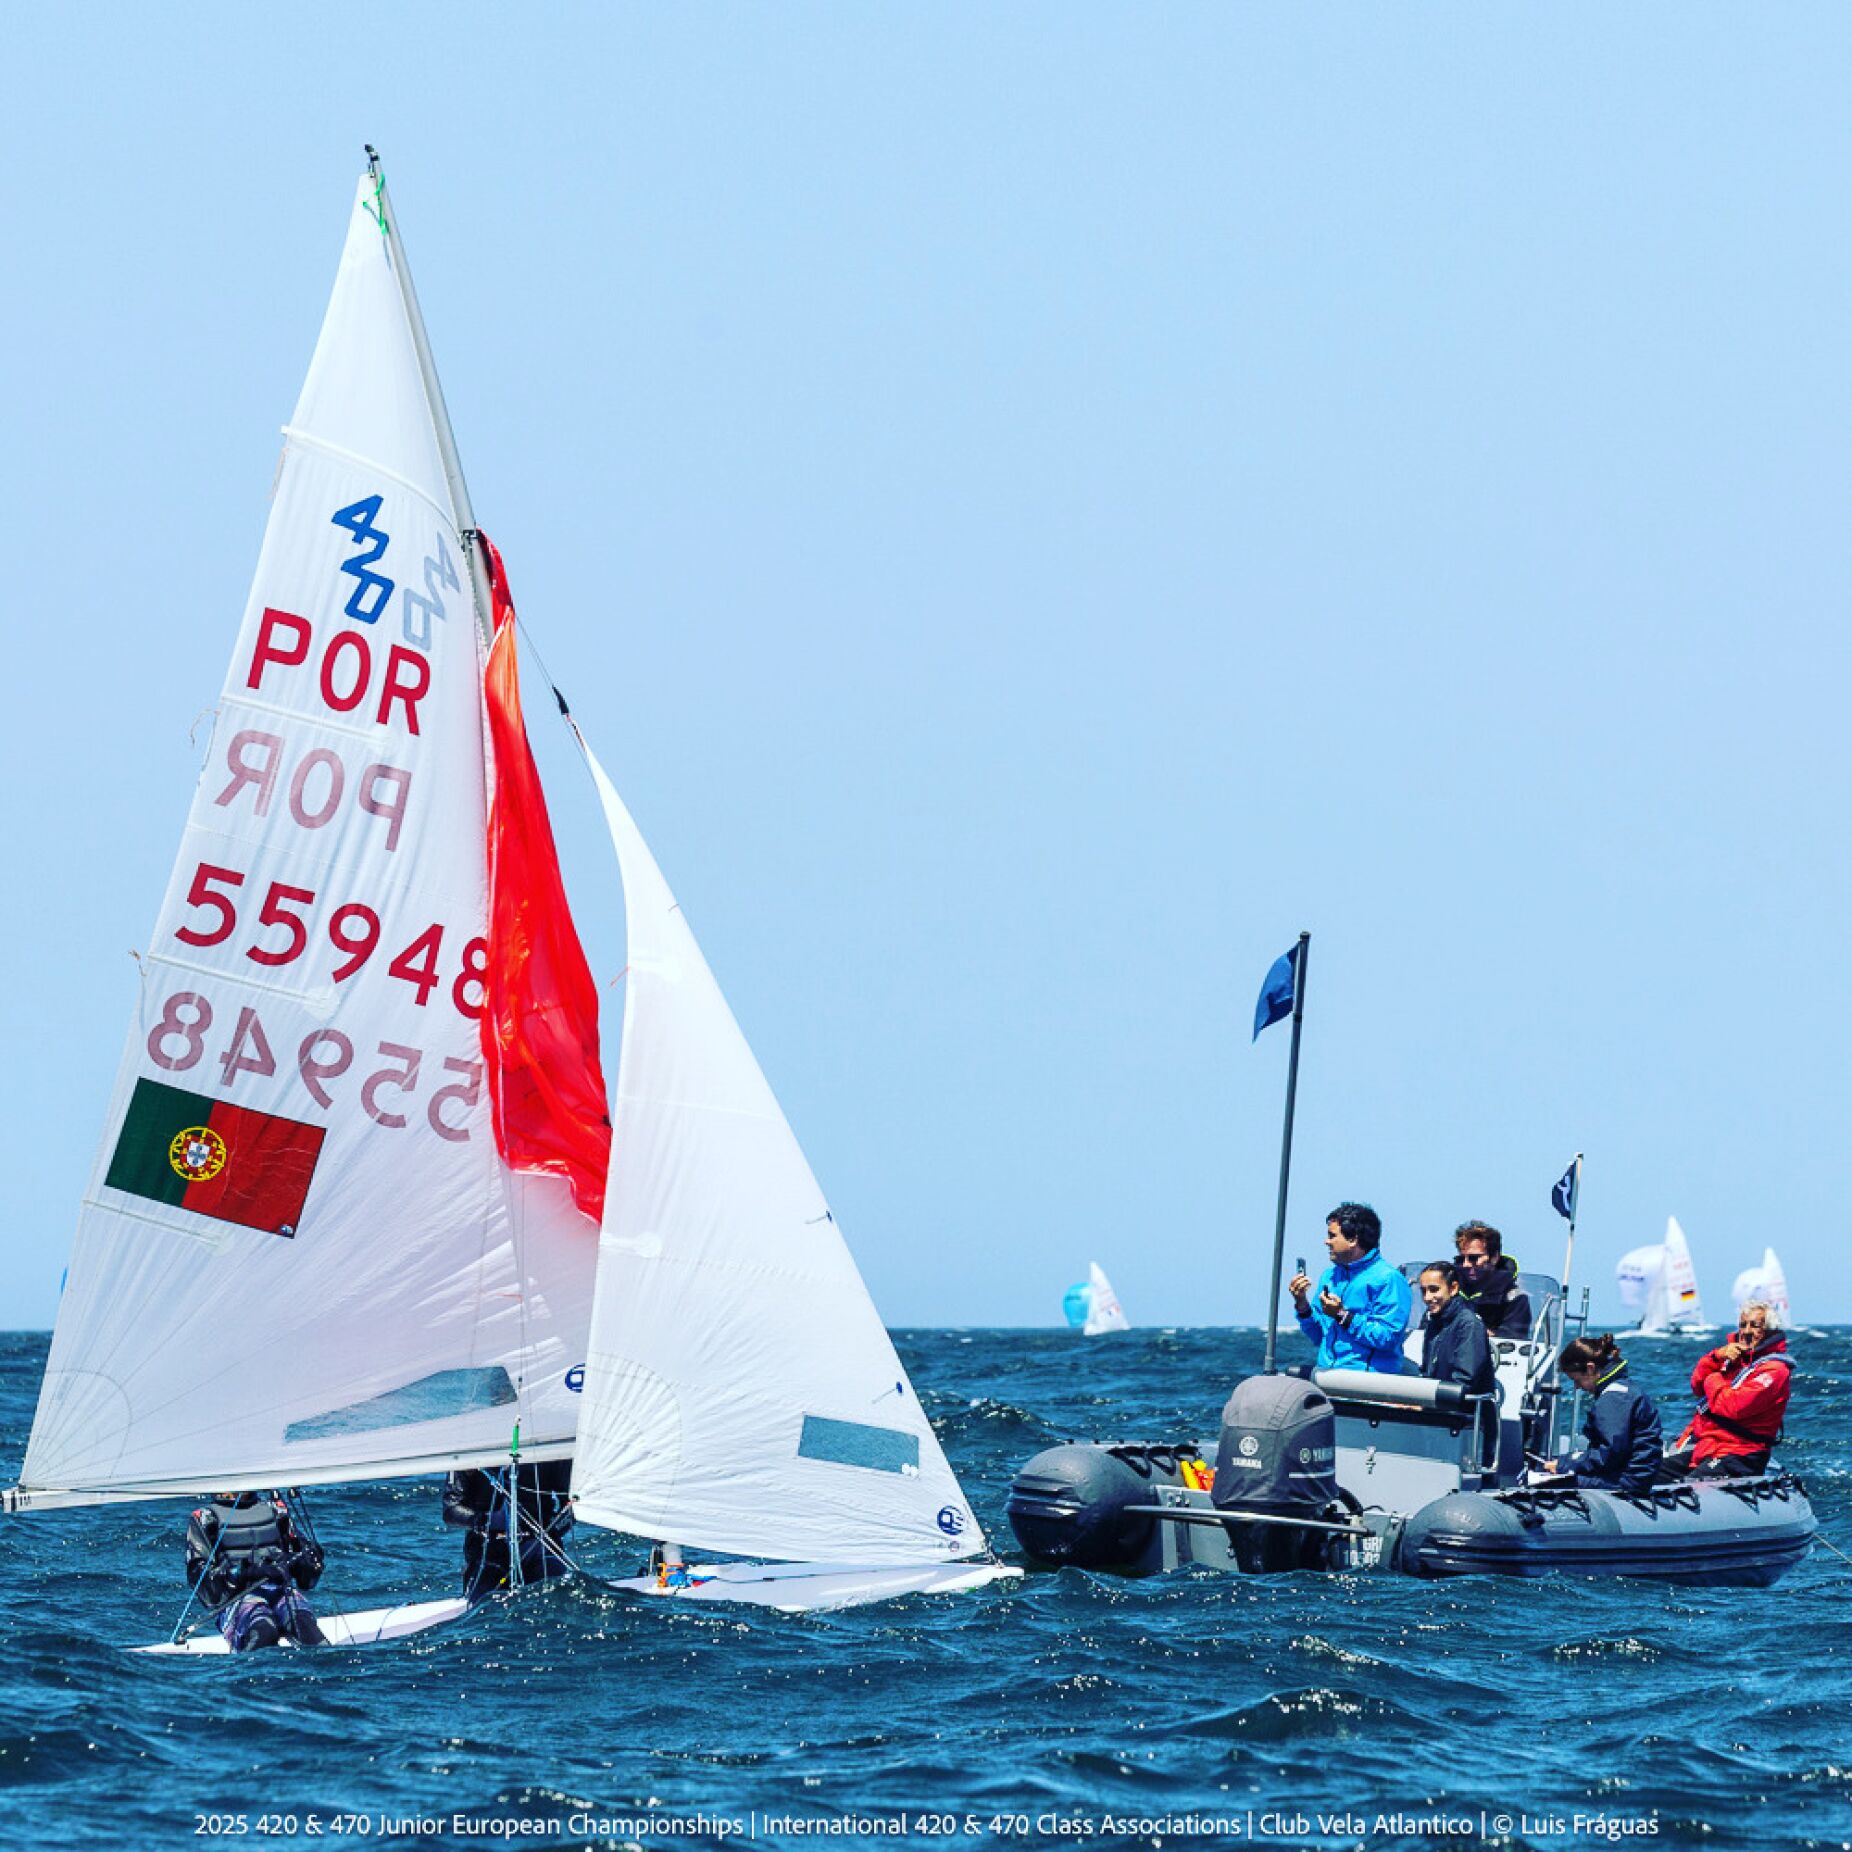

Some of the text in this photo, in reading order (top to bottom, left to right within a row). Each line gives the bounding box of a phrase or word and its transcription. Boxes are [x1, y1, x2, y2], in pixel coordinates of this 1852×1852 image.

[332, 494, 395, 625] 420
[247, 607, 431, 736] POR
[174, 863, 488, 1020] 55948
